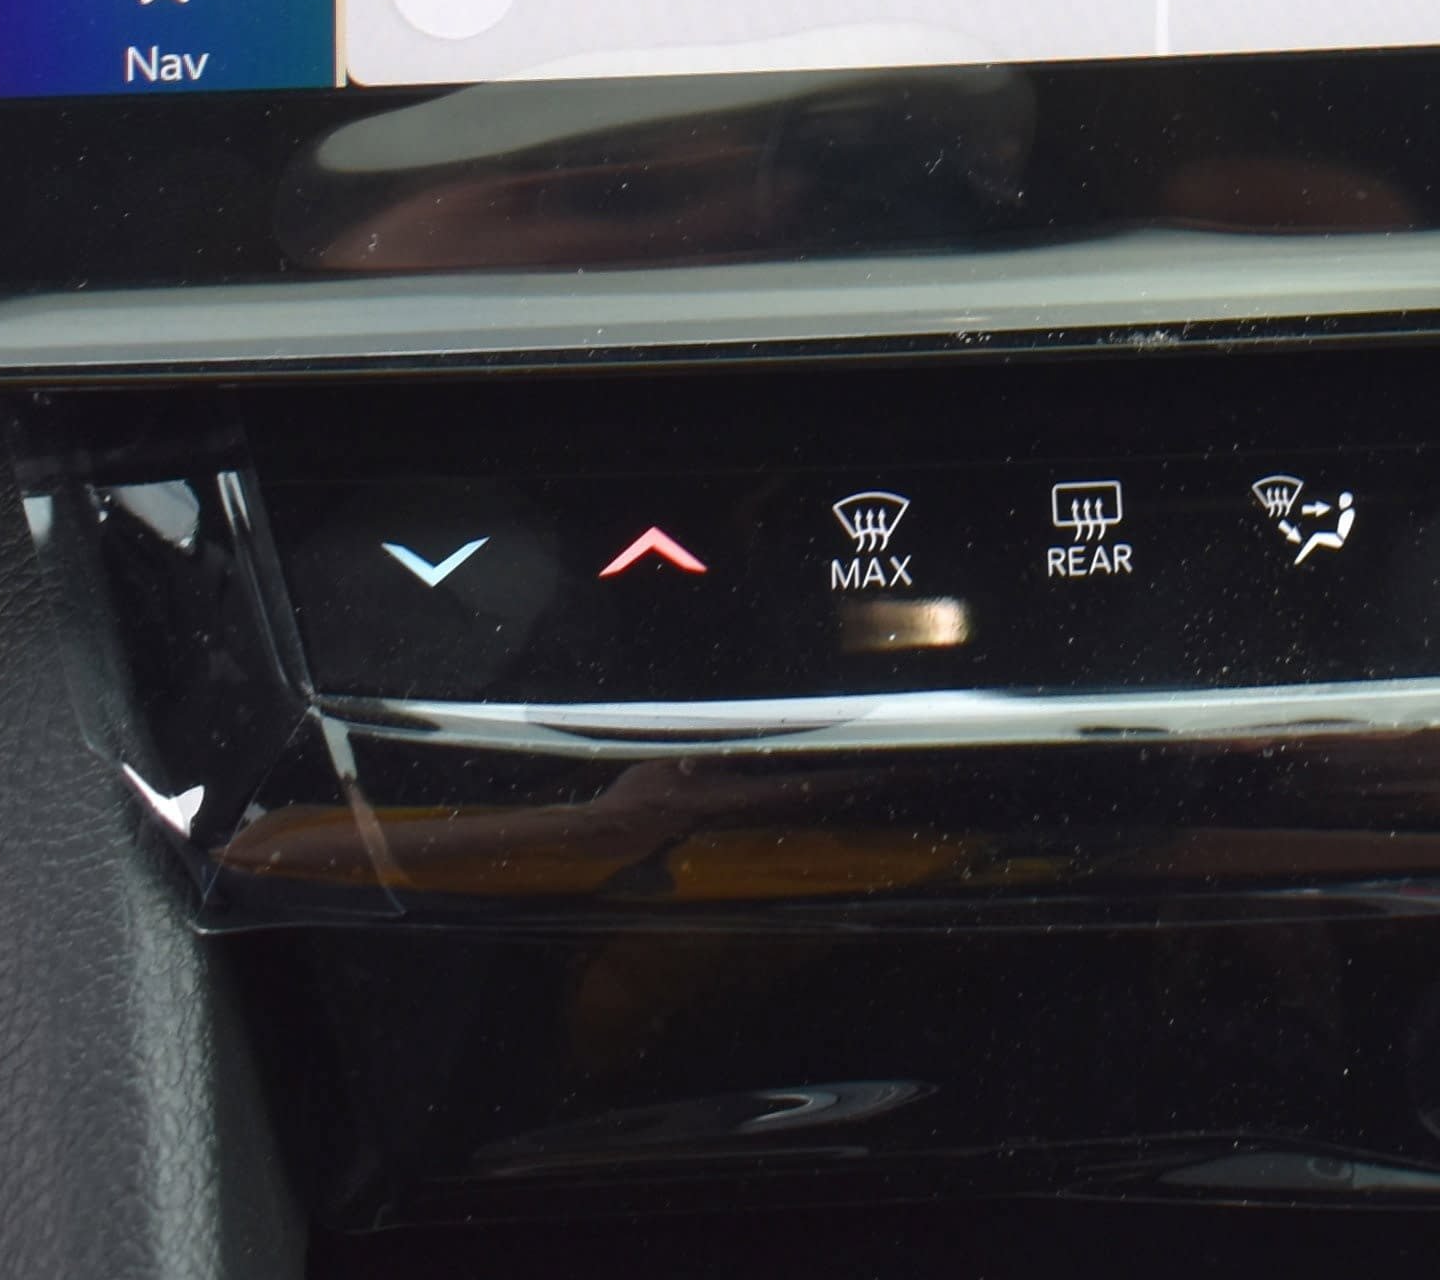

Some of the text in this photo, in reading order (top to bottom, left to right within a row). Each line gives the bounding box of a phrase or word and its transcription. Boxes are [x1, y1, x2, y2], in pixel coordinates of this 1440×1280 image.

[125, 45, 210, 83] Nav
[830, 554, 913, 589] MAX
[1046, 543, 1133, 578] REAR
